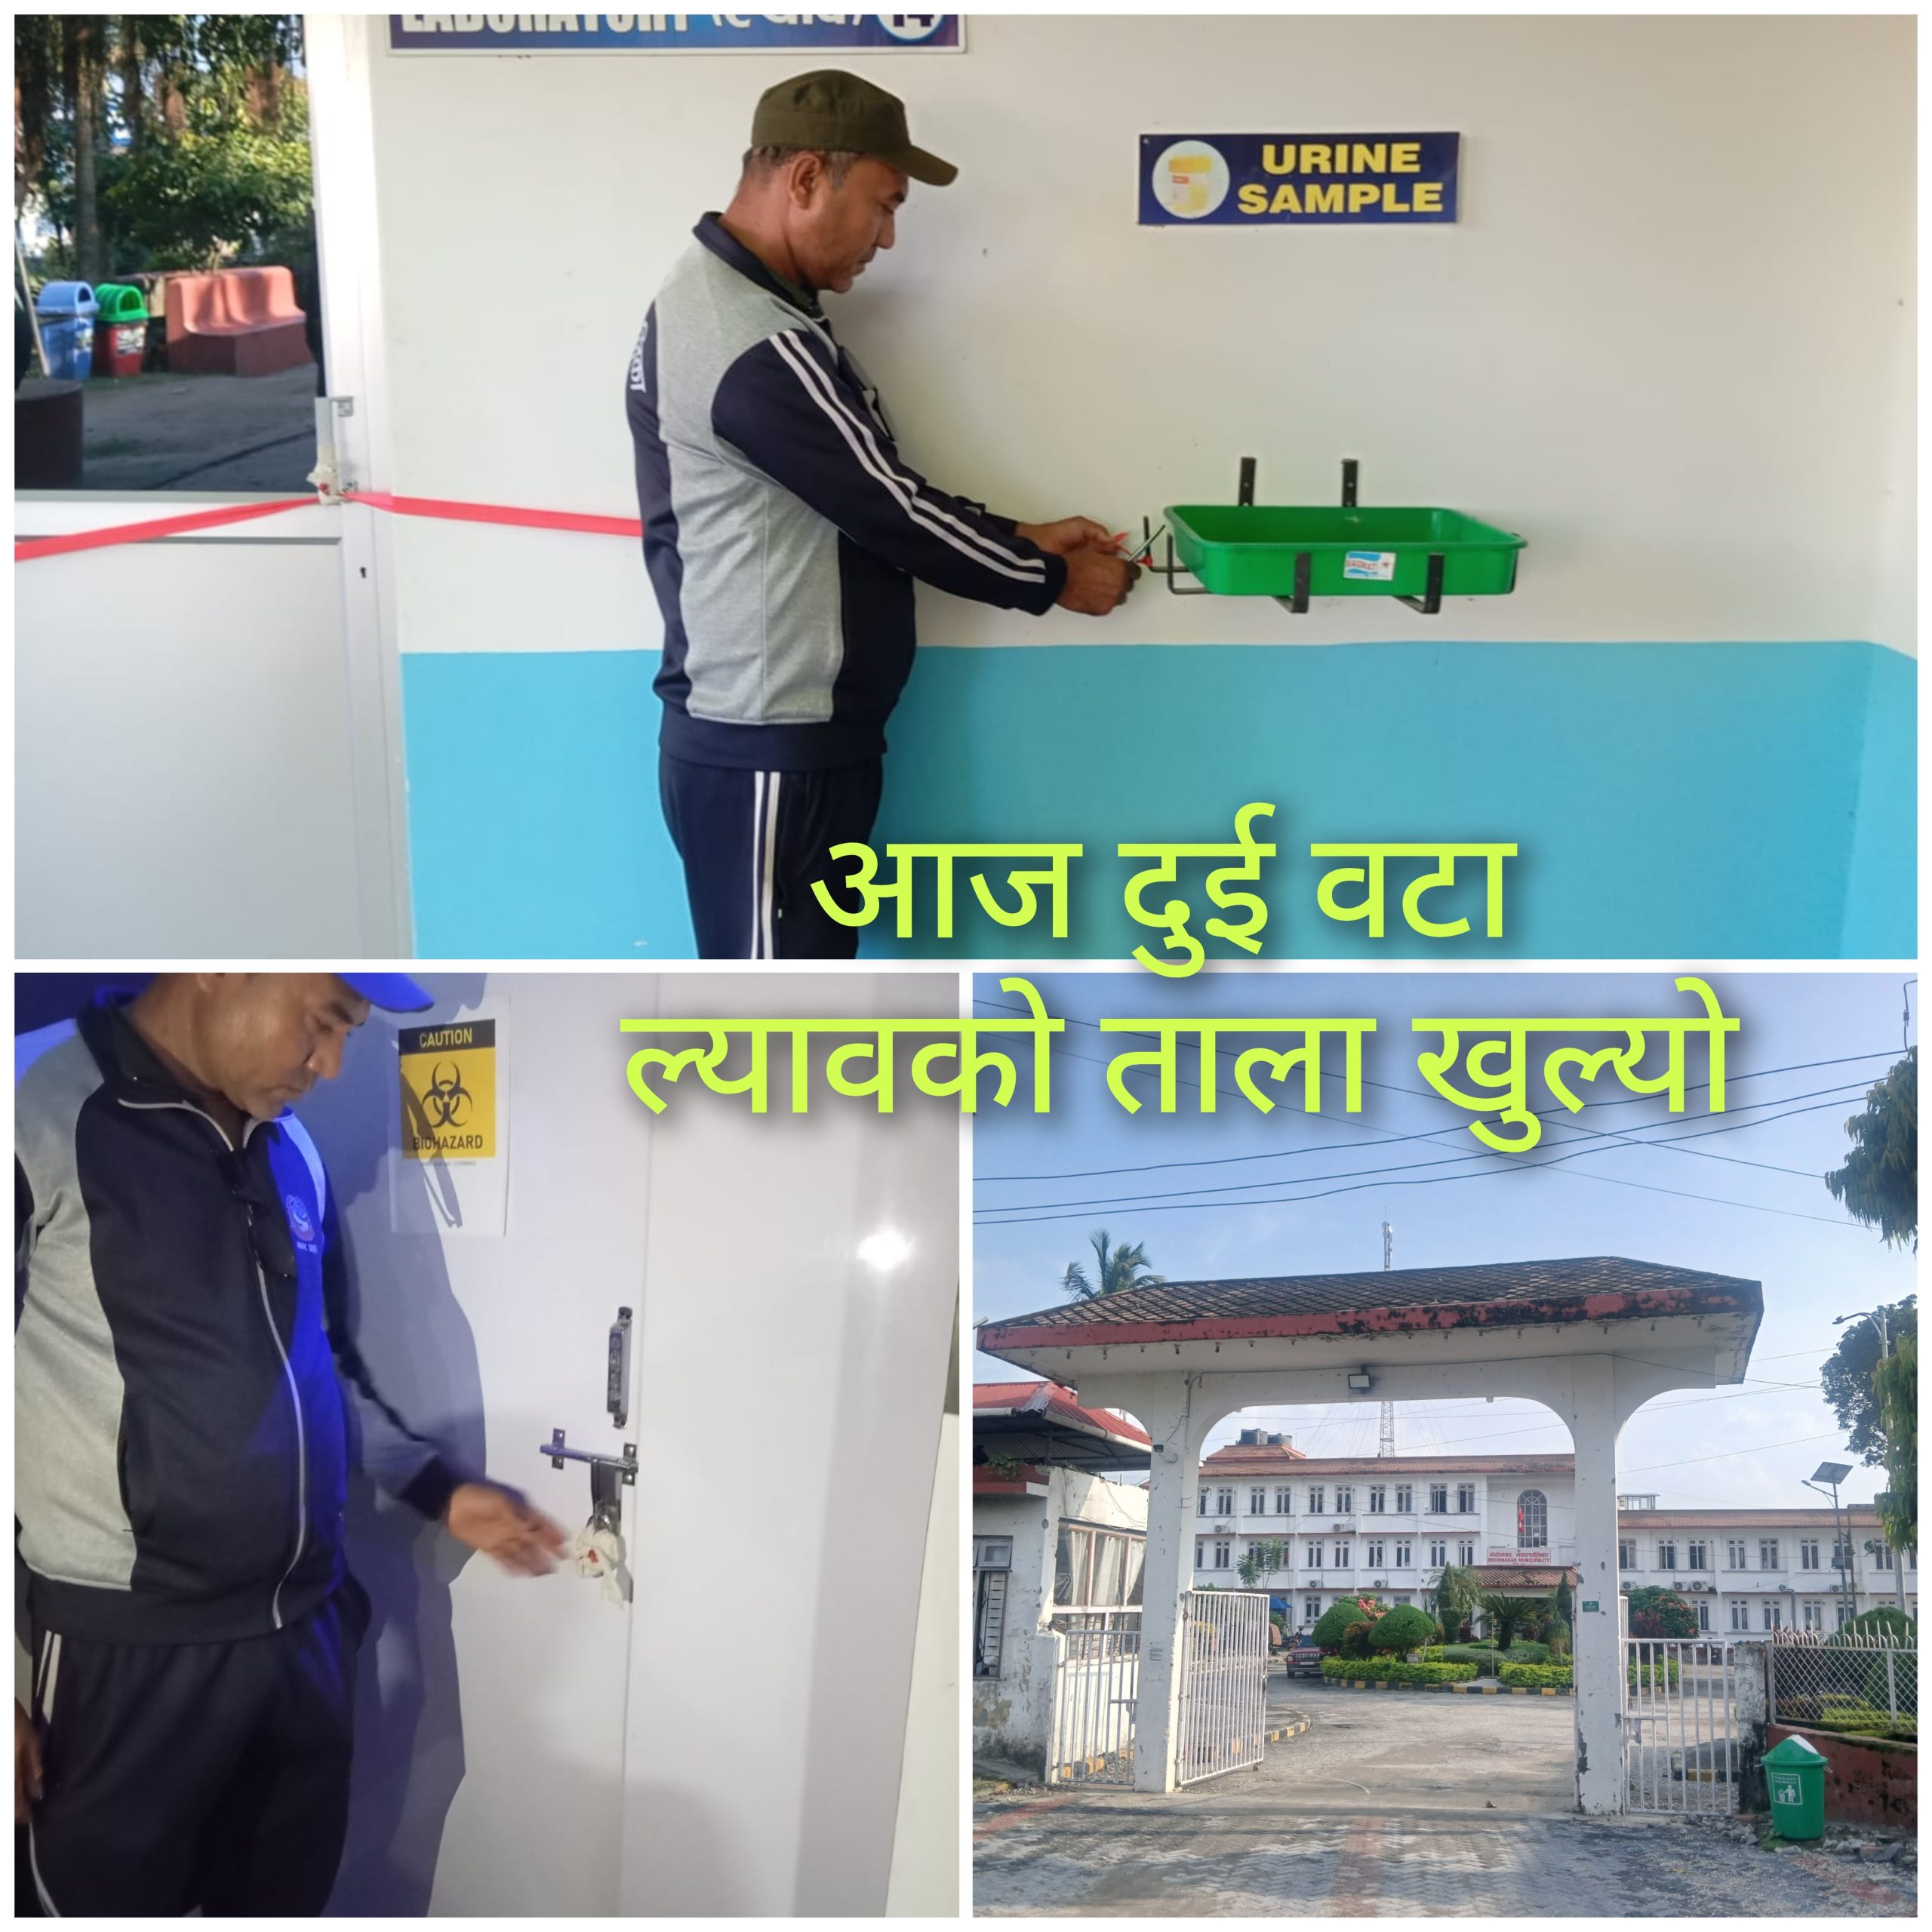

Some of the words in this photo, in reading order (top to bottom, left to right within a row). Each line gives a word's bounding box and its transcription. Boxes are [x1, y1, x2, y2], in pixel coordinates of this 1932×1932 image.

[1262, 143, 1421, 174] URINE
[1238, 183, 1443, 214] SAMPLE
[419, 1028, 472, 1048] CAUTION
[412, 1134, 483, 1151] BIOHAZARD
